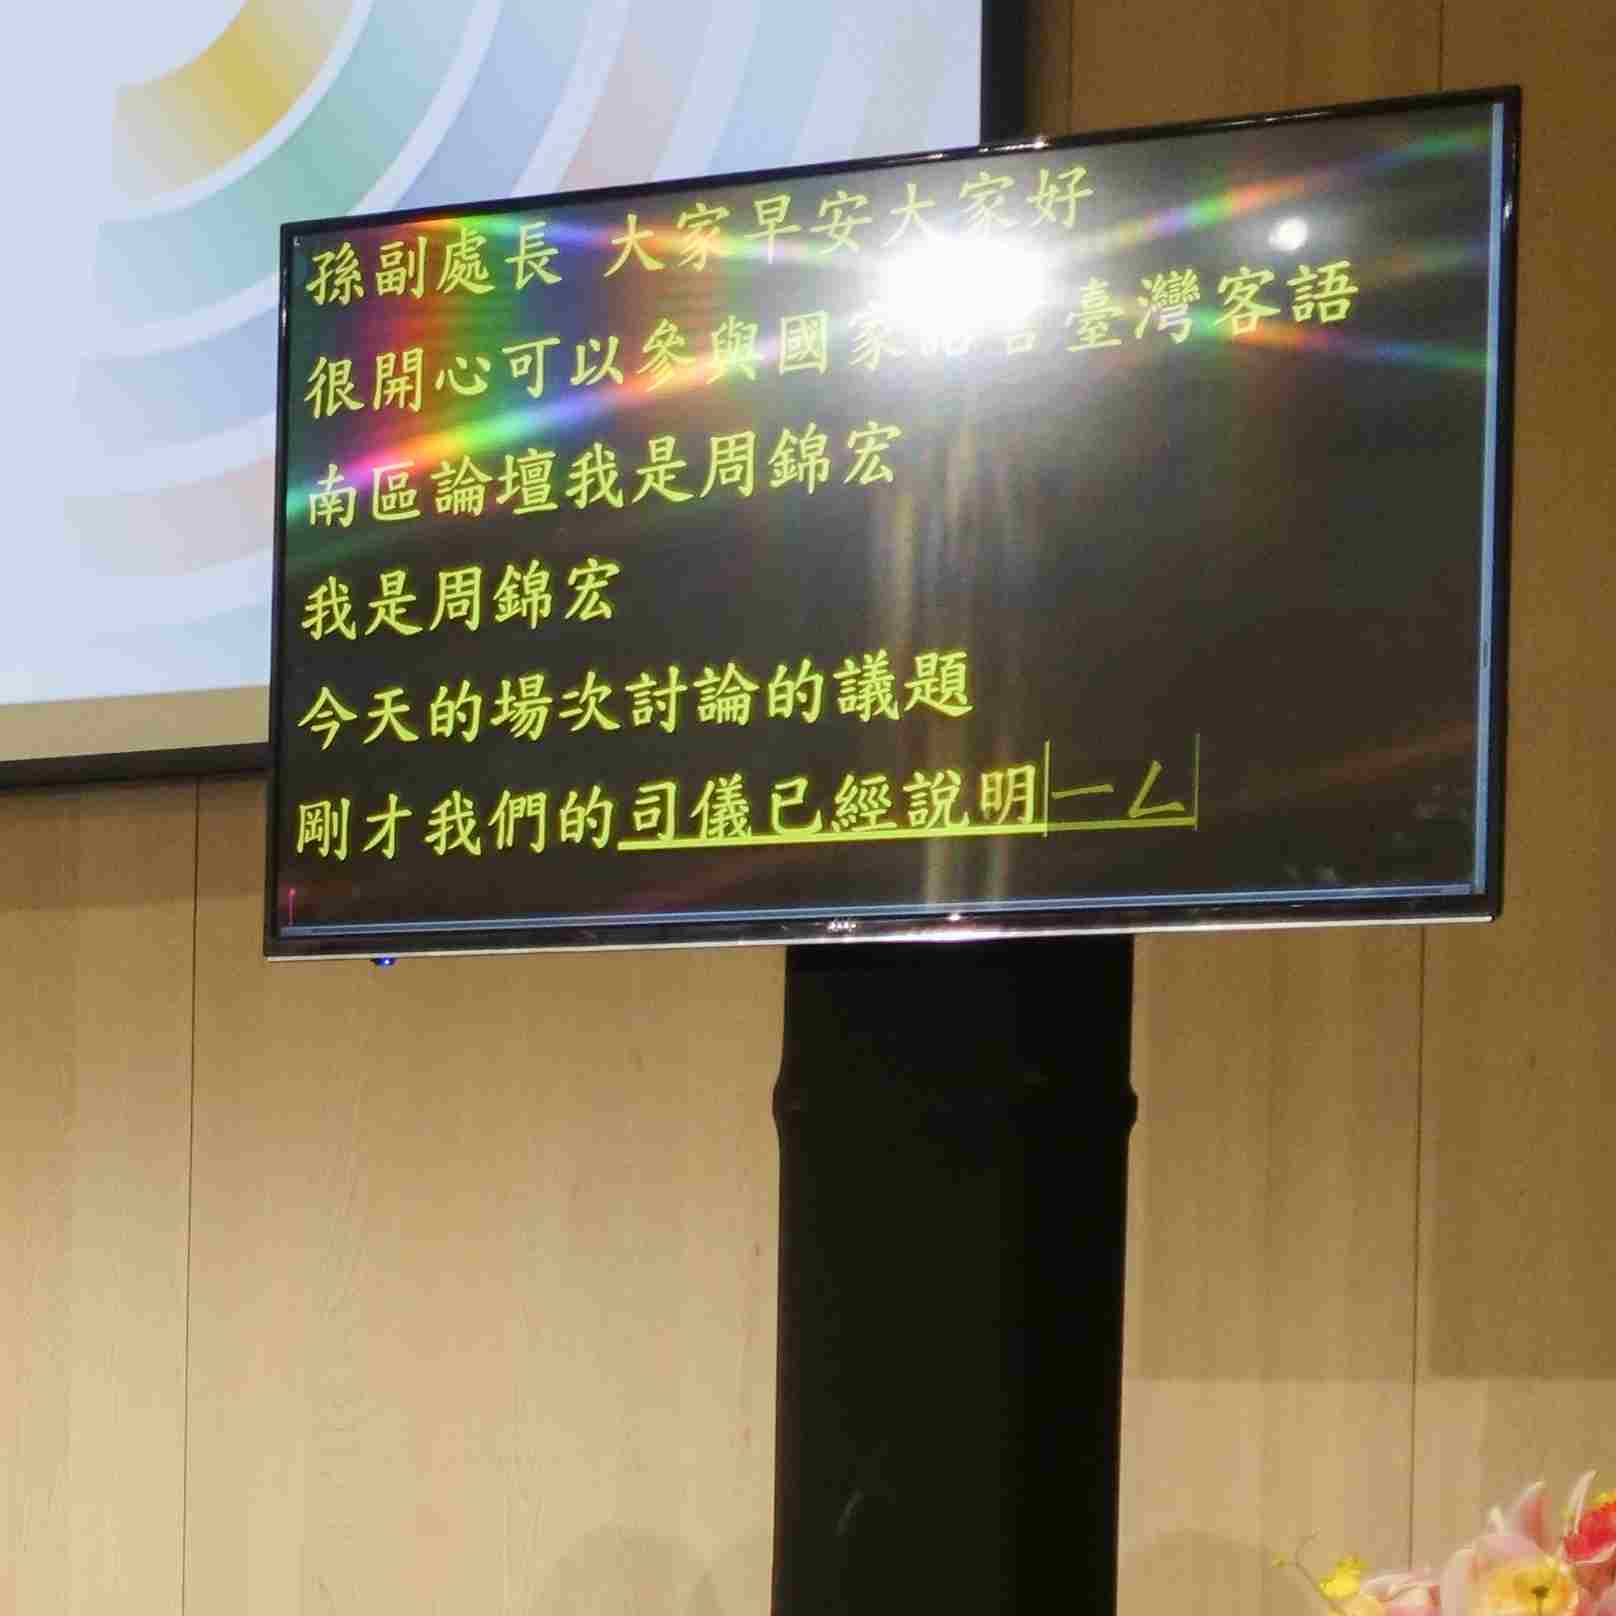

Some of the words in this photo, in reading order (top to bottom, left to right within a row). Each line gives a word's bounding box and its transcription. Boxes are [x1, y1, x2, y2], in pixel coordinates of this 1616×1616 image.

[306, 219, 563, 306] 孫副處長
[604, 167, 1095, 279] 大家早安大家好
[307, 421, 903, 528] 南區論壇我是周錦宏
[301, 558, 621, 641] 我是周錦宏
[297, 649, 974, 750] 今天的場次討論的議題
